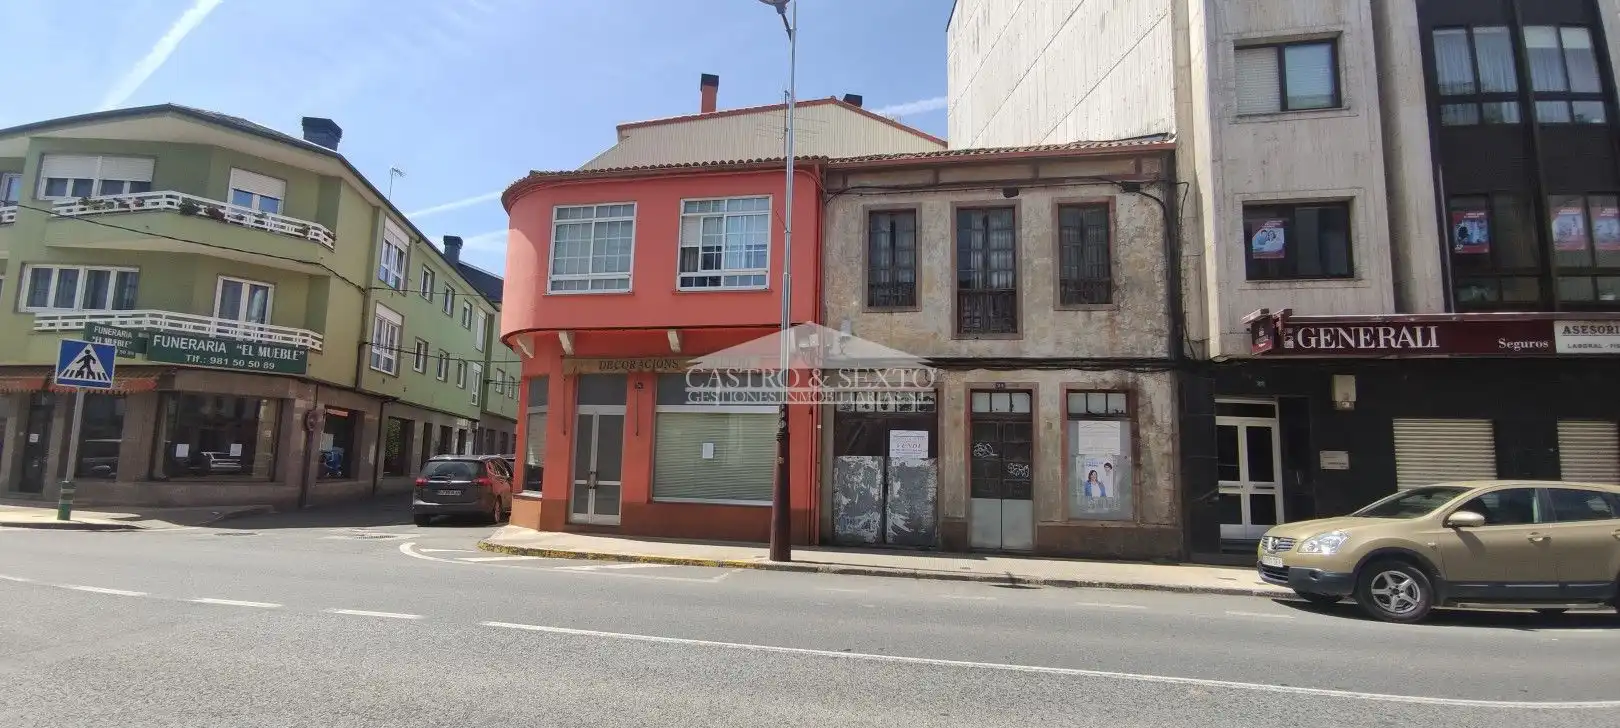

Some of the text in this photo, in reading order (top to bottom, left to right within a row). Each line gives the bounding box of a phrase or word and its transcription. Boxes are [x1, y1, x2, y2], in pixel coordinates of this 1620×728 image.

[94, 325, 133, 339] FUNERARIA
[1297, 325, 1549, 351] GENERALI Seguros
[153, 334, 227, 353] FUNERARIA
[209, 356, 229, 365] 981
[233, 358, 245, 367] 50
[248, 360, 260, 368] 50
[263, 361, 275, 370] 89
[599, 359, 679, 370] DECORACIONS
